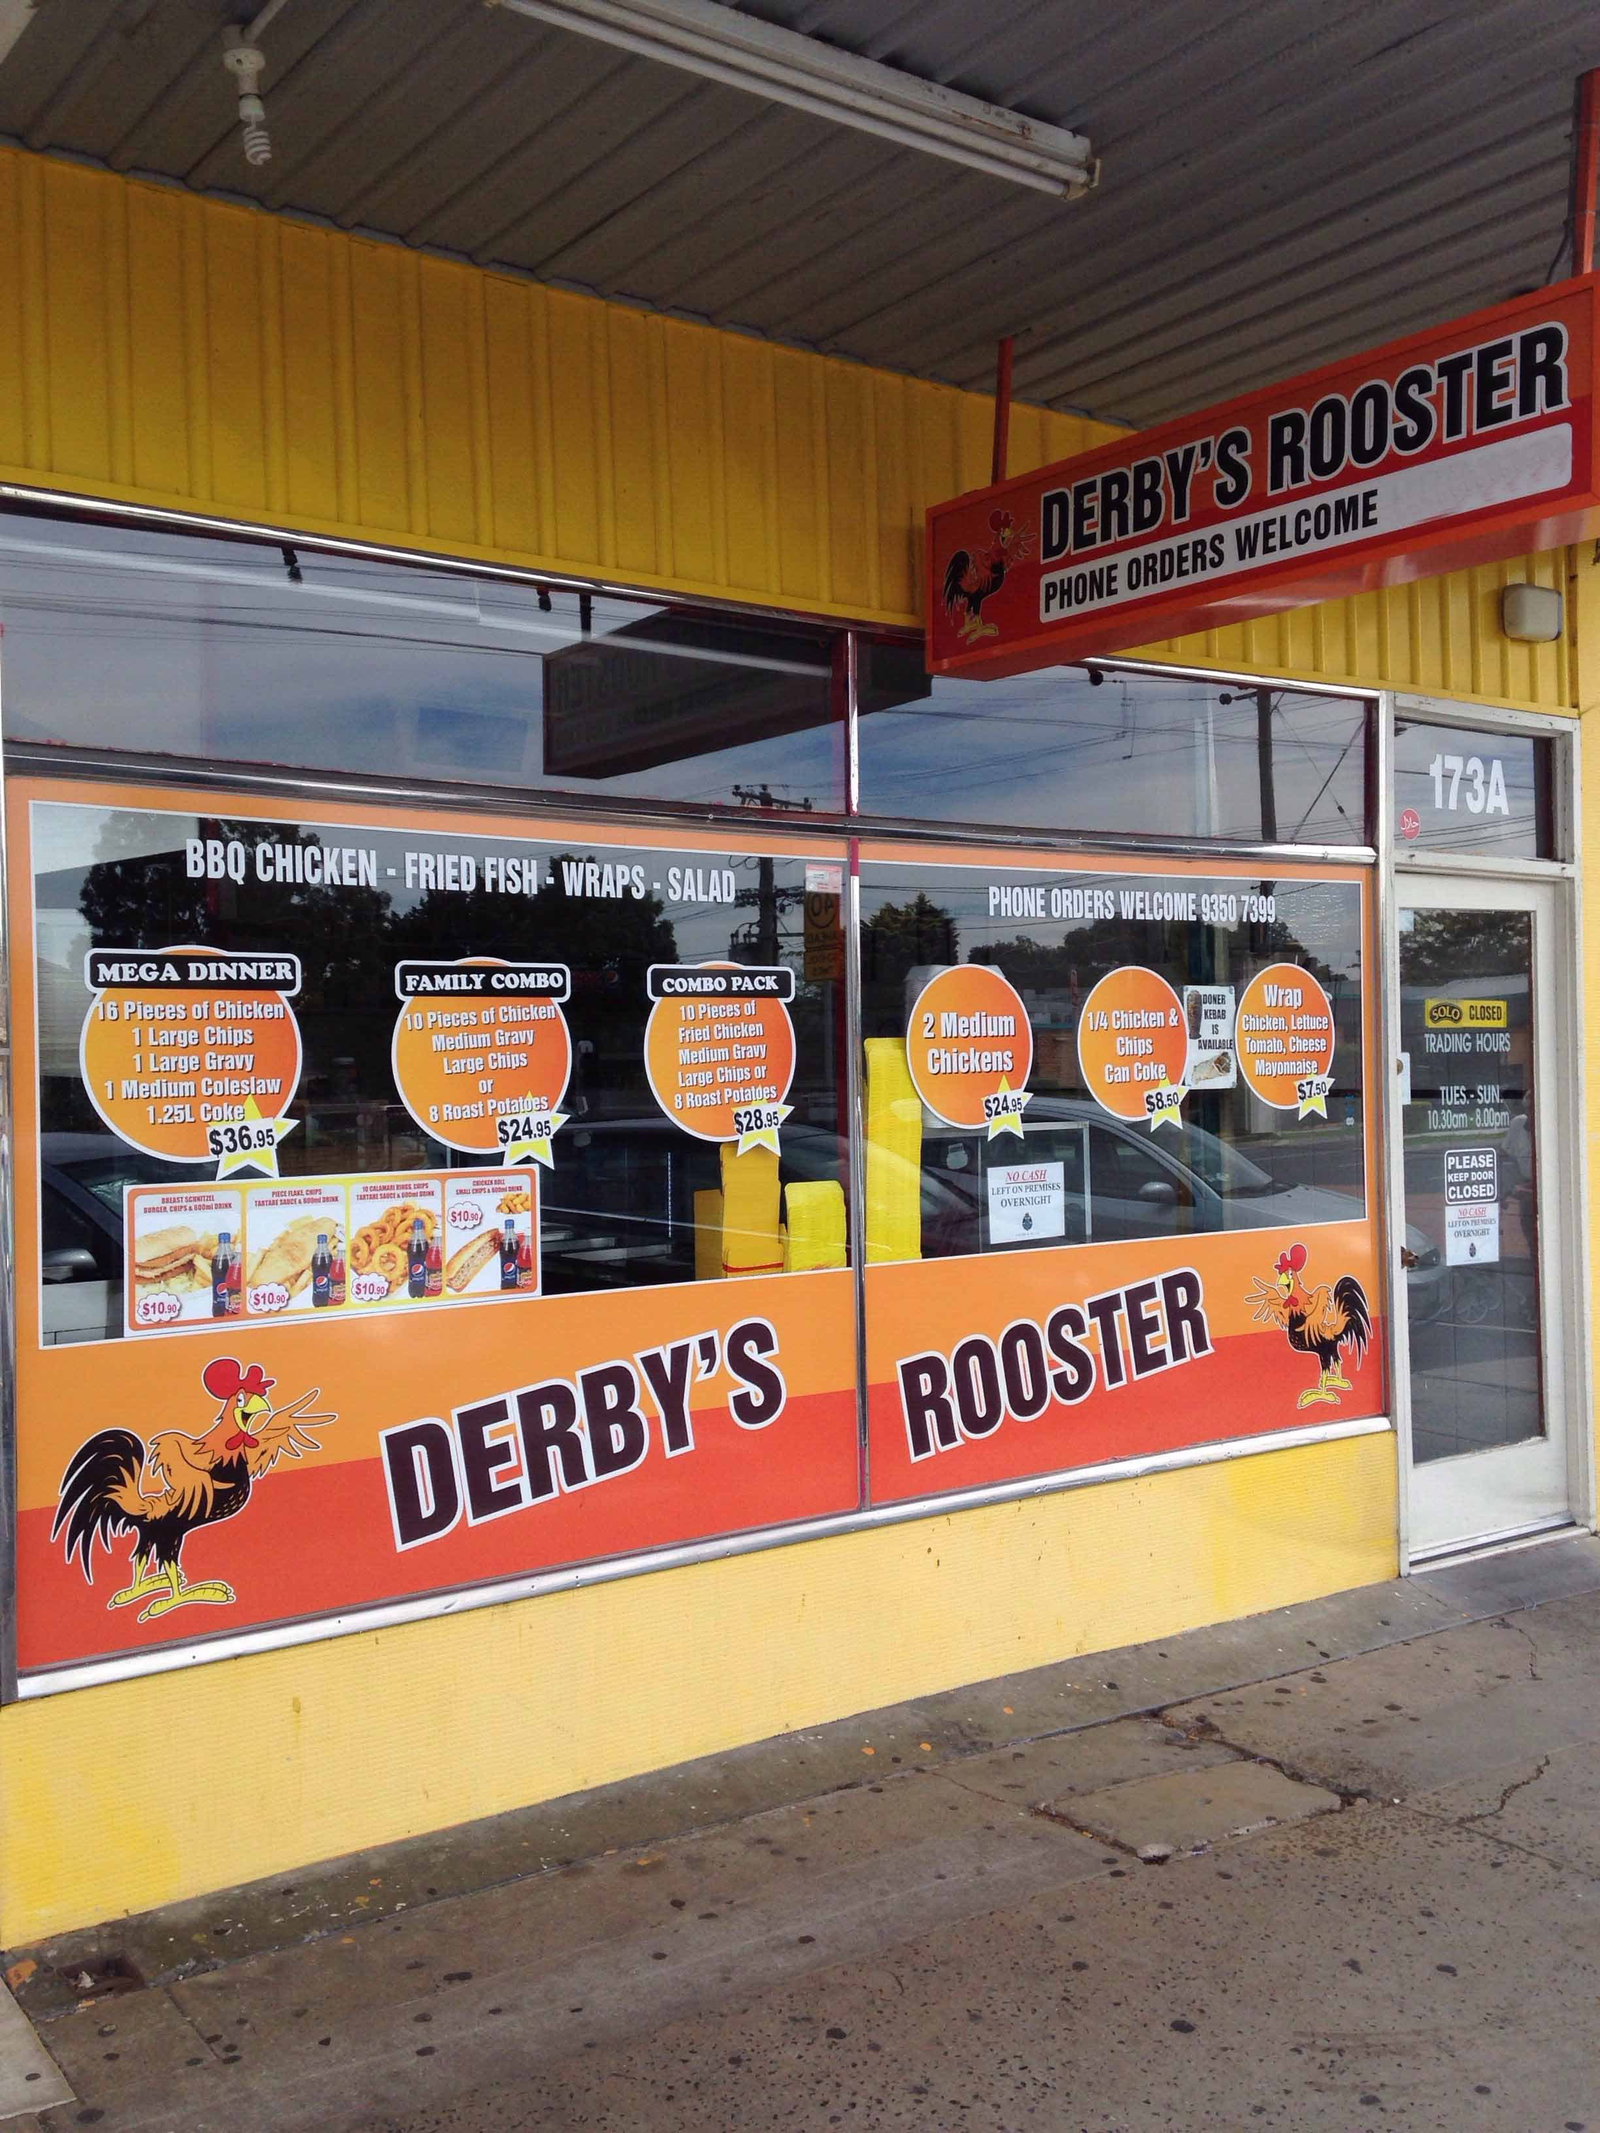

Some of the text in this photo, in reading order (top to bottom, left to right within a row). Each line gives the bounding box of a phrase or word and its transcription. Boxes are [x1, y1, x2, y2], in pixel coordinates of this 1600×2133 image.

[1041, 321, 1572, 564] DERBY'S ROOSTER
[1044, 489, 1378, 613] PHONE ORDERS WELCOME
[1430, 754, 1509, 815] 173A
[186, 839, 245, 885] BBQ
[256, 843, 377, 887] CHICKEN
[405, 852, 476, 891] FRIED
[484, 857, 538, 894] FISH
[562, 862, 645, 900] WRAPS
[668, 866, 735, 902] SALAD
[989, 887, 1276, 923] PHONE ORDERS WELCOME 9350 7399
[97, 963, 294, 982] MEGA DINNER
[405, 973, 563, 991] FAMILY COMBO
[663, 976, 779, 993] COMBO PACK
[1203, 994, 1225, 1004] DONER
[1263, 985, 1302, 1009] Wrap
[98, 1001, 284, 1021] 16 Pieces of Chicken
[405, 1005, 556, 1031] 10 Pieces of Chicken
[680, 1000, 756, 1021] 10 Pieces of
[1087, 1008, 1179, 1032] 1/4 Chicken &
[1204, 1009, 1226, 1019] KEBAB
[1432, 1005, 1502, 1020] SOLO CLOSED
[679, 1023, 764, 1044] Fried Chicken
[923, 1012, 1015, 1038] 2 Medium
[1212, 1024, 1219, 1034] IS
[1242, 1014, 1328, 1032] Chicken, Lettuce
[132, 1027, 253, 1048] 1 Large Chips
[432, 1029, 534, 1052] Medium Gravy
[1116, 1037, 1153, 1057] Chips
[1198, 1040, 1232, 1049] AVAILABLE
[1245, 1036, 1326, 1054] Tomato, Cheese
[1425, 1033, 1510, 1052] TRADING HOURS
[133, 1052, 254, 1073] 1 Large Gravy
[443, 1052, 528, 1075] Large Chips
[679, 1044, 766, 1065] Medium Gravy
[927, 1047, 1014, 1075] Chickens
[678, 1065, 767, 1088] Large Chips or
[1104, 1062, 1166, 1083] Can Coke
[1255, 1060, 1318, 1077] Mayonnaise
[105, 1078, 281, 1099] 1 Medium Coleslaw
[478, 1080, 494, 1094] or
[675, 1084, 777, 1110] 8 Roast Potatoes
[1298, 1081, 1327, 1101] $7.50
[1440, 1086, 1469, 1105] TUES.
[1477, 1085, 1503, 1104] SUN.
[429, 1096, 548, 1122] 8 Roast Potatoes
[985, 1095, 1022, 1118] $24.95
[1146, 1091, 1178, 1113] $8.50
[148, 1102, 245, 1124] 1.25L Coke
[734, 1108, 779, 1135] $28.95
[1428, 1109, 1467, 1129] 10.30am
[1476, 1108, 1509, 1129] 8.00pm
[209, 1125, 275, 1158] $36.95
[498, 1117, 551, 1146] $24.95
[1448, 1155, 1493, 1169] PLEASE
[1007, 1170, 1047, 1181] NO CASH
[1448, 1172, 1493, 1182] KEEP DOOR
[992, 1183, 1060, 1195] LEFT ON PREMISES
[1449, 1184, 1494, 1199] CLOSED
[1001, 1195, 1051, 1207] OVERNIGHT
[1469, 1207, 1487, 1216] CASH
[451, 1209, 478, 1222] $10.90
[1454, 1229, 1490, 1238] OVERNIGHT
[254, 1293, 285, 1305] $10.90
[355, 1283, 384, 1296] $10.90
[143, 1301, 177, 1316] $10.90
[379, 1266, 1214, 1552] DERBY'S ROOSTER
